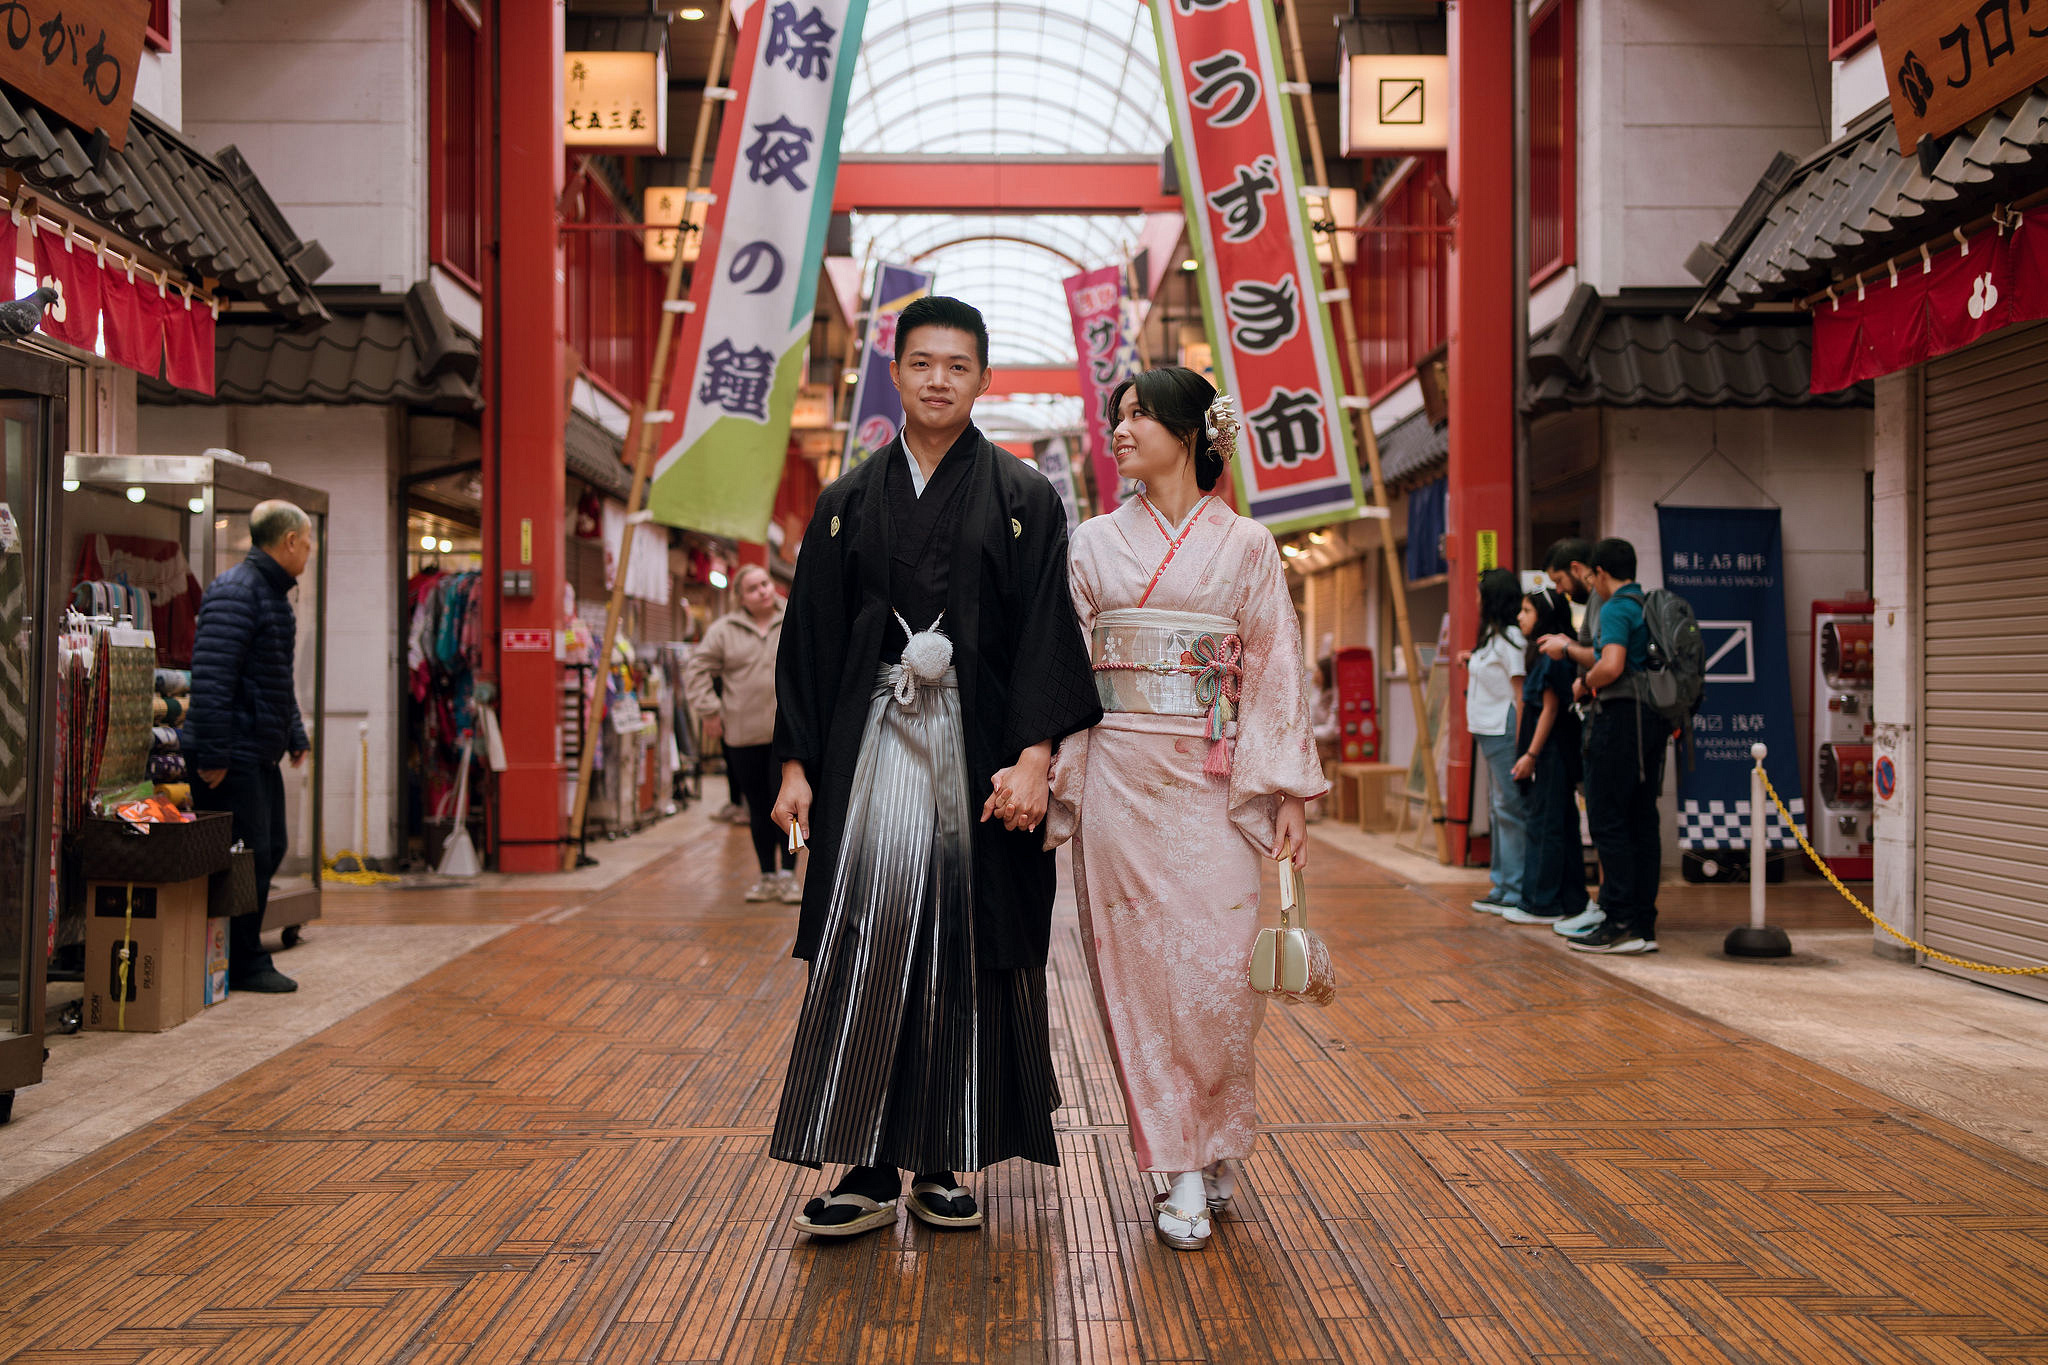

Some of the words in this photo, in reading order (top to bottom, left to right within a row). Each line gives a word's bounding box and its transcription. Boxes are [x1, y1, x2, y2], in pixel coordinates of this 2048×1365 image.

[699, 1, 836, 419] 除夜の鐘
[1710, 553, 1732, 570] A5
[1668, 575, 1717, 587] PREMIUM
[1735, 576, 1774, 588] WAGYU
[1704, 750, 1754, 760] ASAKUS
[91, 992, 101, 1025] EPSON
